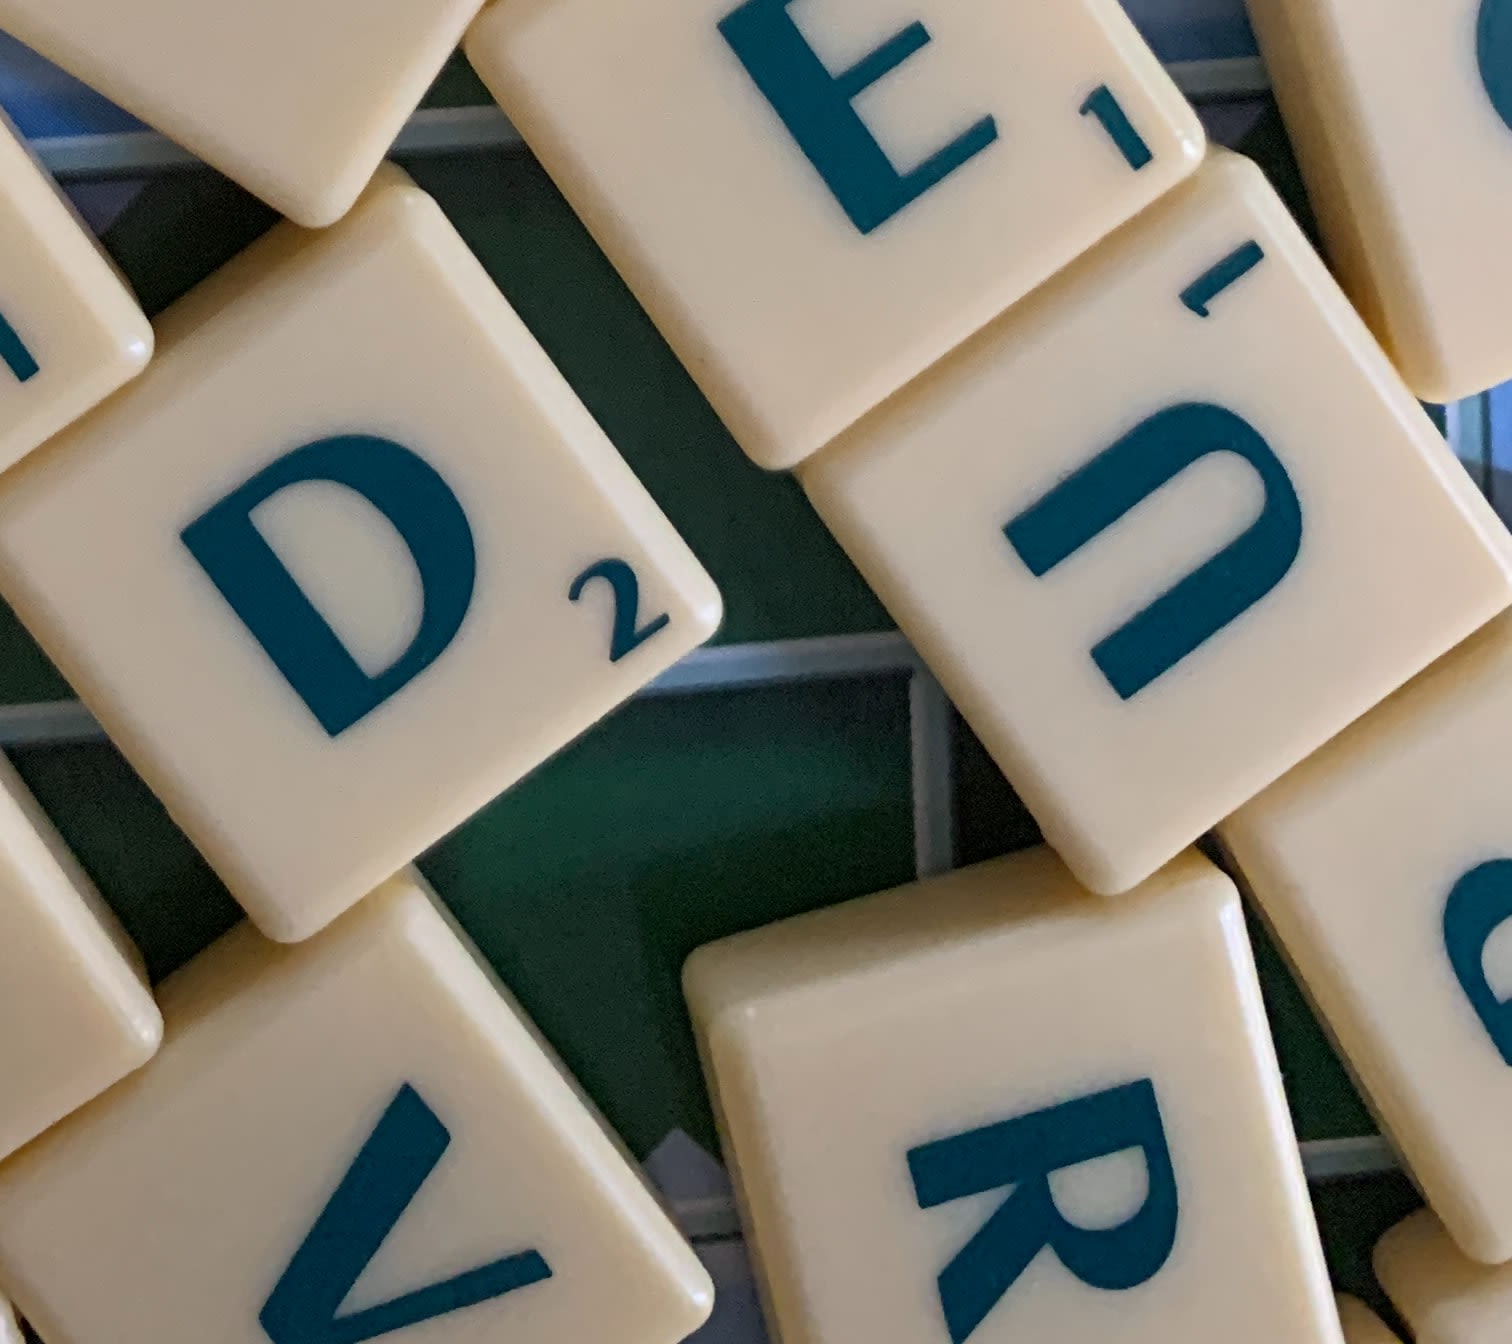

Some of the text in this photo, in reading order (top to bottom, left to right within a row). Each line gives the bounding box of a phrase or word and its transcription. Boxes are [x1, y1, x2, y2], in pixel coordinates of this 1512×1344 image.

[1080, 85, 1152, 170] 1
[1180, 242, 1264, 318] 1
[180, 435, 476, 737] D
[569, 559, 668, 662] 2
[1004, 402, 1302, 700] U
[259, 1082, 552, 1344] V
[907, 1078, 1178, 1344] R
